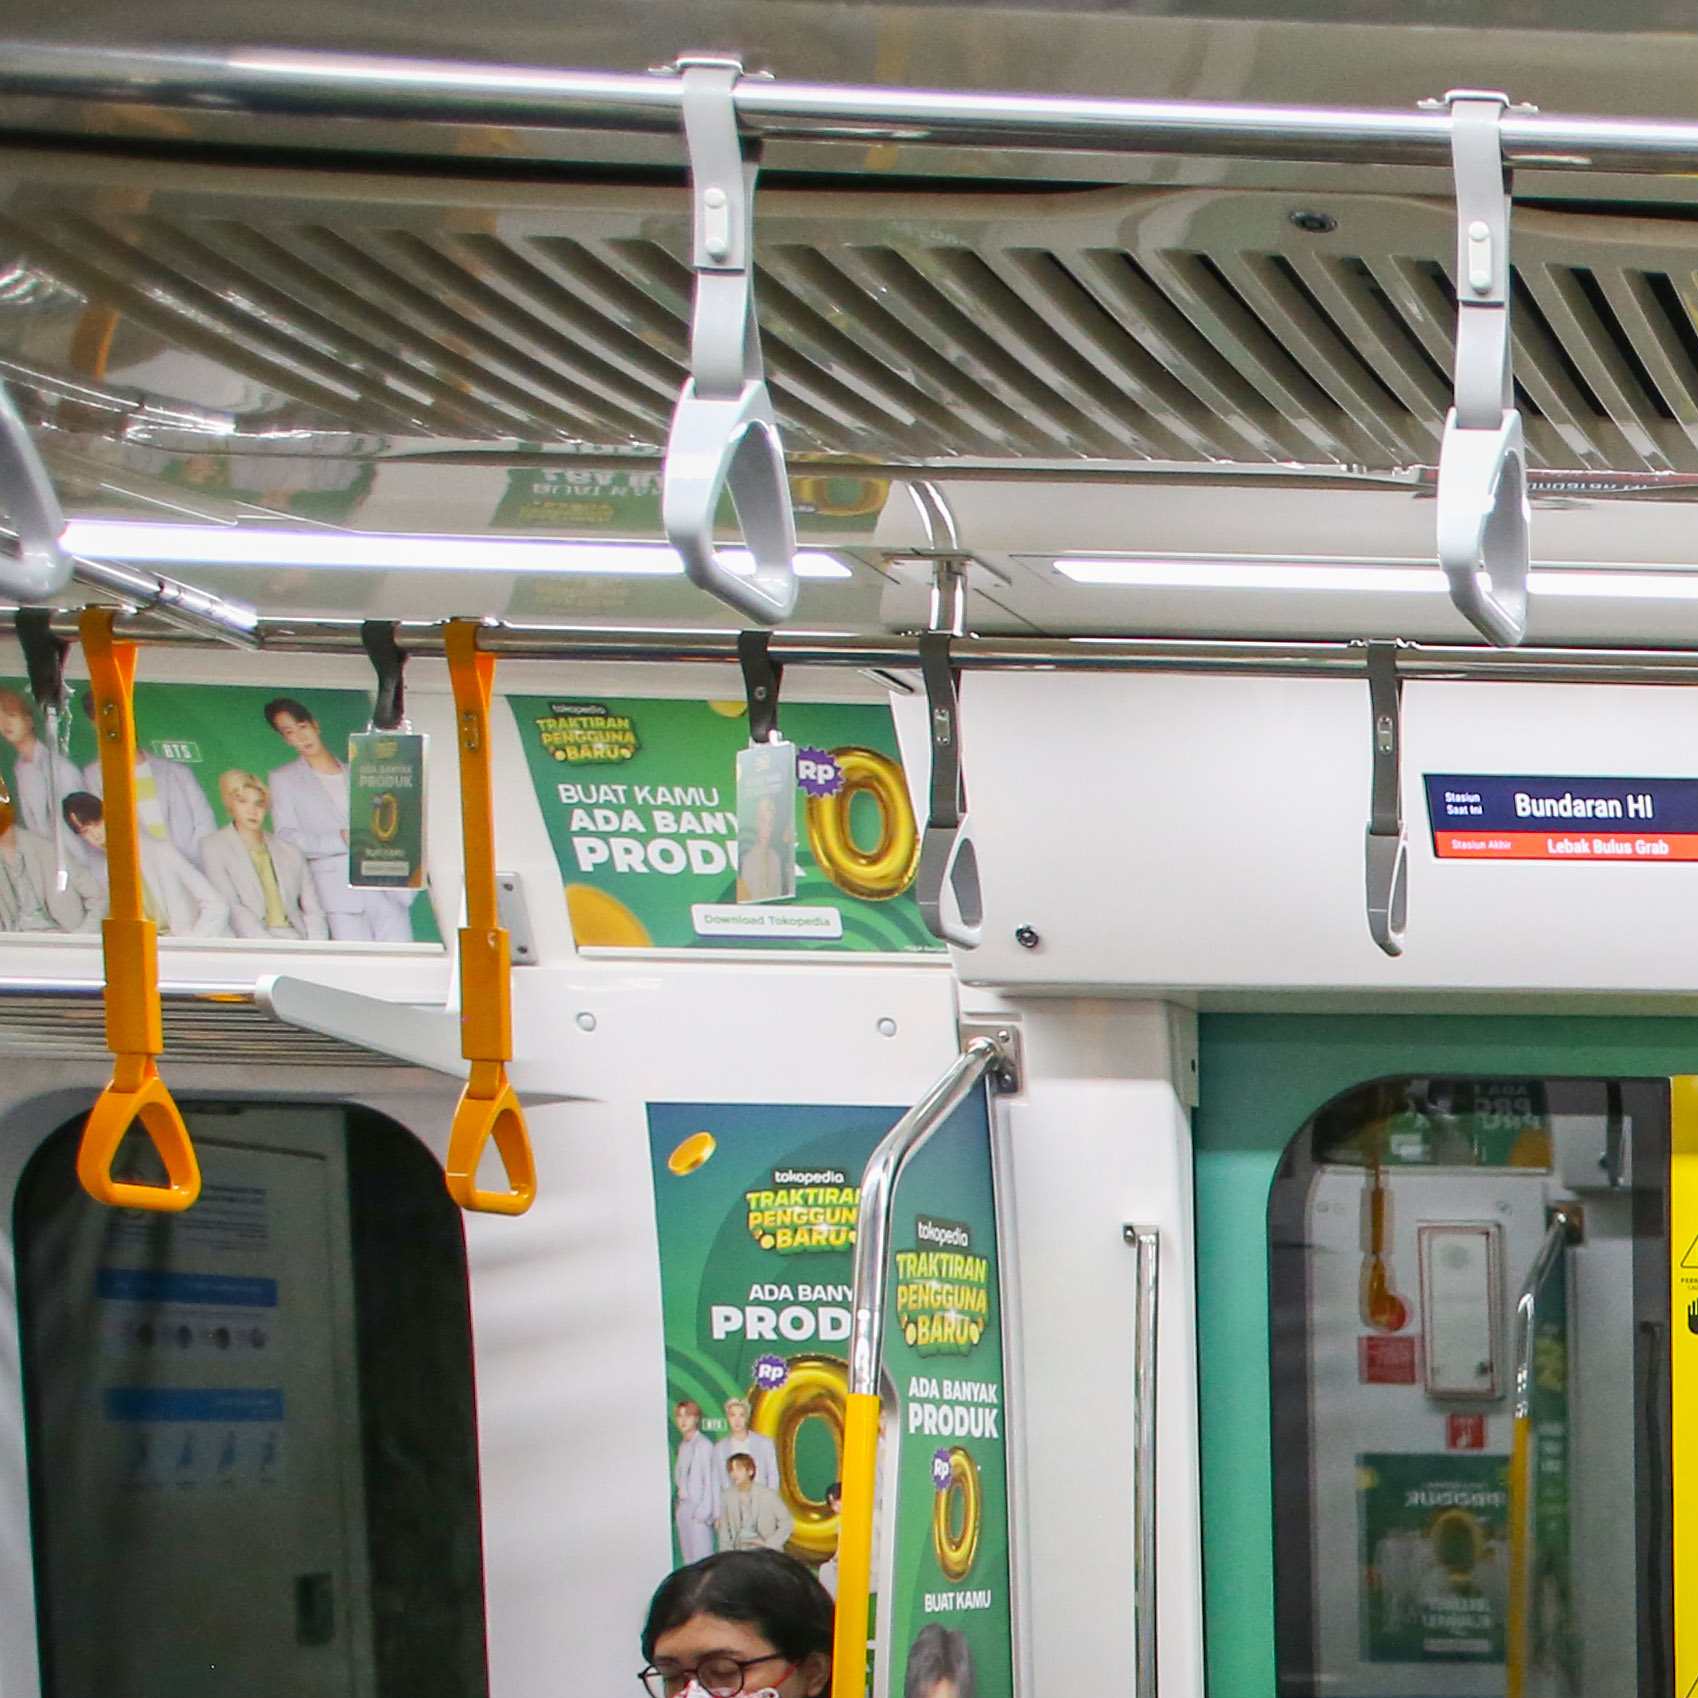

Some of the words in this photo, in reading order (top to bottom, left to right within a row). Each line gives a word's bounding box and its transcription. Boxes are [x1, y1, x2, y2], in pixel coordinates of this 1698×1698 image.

[536, 716, 630, 731] TRAKTIRAN
[541, 730, 636, 746] PENGGUNA
[162, 742, 191, 759] BTS
[566, 745, 622, 761] BARU
[798, 761, 835, 785] Rp
[558, 783, 628, 804] BUAT
[634, 785, 720, 807] KAMU
[1445, 791, 1481, 803] Stasiun
[1514, 792, 1623, 819] Bundaran
[1627, 794, 1655, 818] HI
[570, 808, 646, 832] ADA
[652, 810, 738, 834] BANY
[573, 836, 806, 876] PROD
[1451, 839, 1487, 851] Stasiun
[1488, 839, 1512, 850] Akhir
[1547, 838, 1590, 854] Lebak
[1593, 838, 1632, 854] Bulus
[1635, 839, 1670, 855] Grab
[775, 1170, 844, 1185] tokopedia
[748, 1206, 858, 1230] PENGGUN
[776, 1226, 849, 1248] BARU
[917, 1221, 969, 1247] tokopedia
[895, 1252, 988, 1283] TRAKTIRAN
[749, 1284, 794, 1301] ADA
[800, 1285, 853, 1302] BANY
[896, 1285, 988, 1315] PENGGUNA
[711, 1306, 850, 1340] PROD
[916, 1315, 971, 1345] BARU
[758, 1363, 785, 1382] Rp
[909, 1377, 939, 1399] ADA
[943, 1379, 998, 1404] BANYAK
[909, 1404, 999, 1438] PRODUK
[934, 1458, 950, 1480] Rp
[924, 1591, 957, 1613] BUAT
[957, 1590, 991, 1610] KAMU
